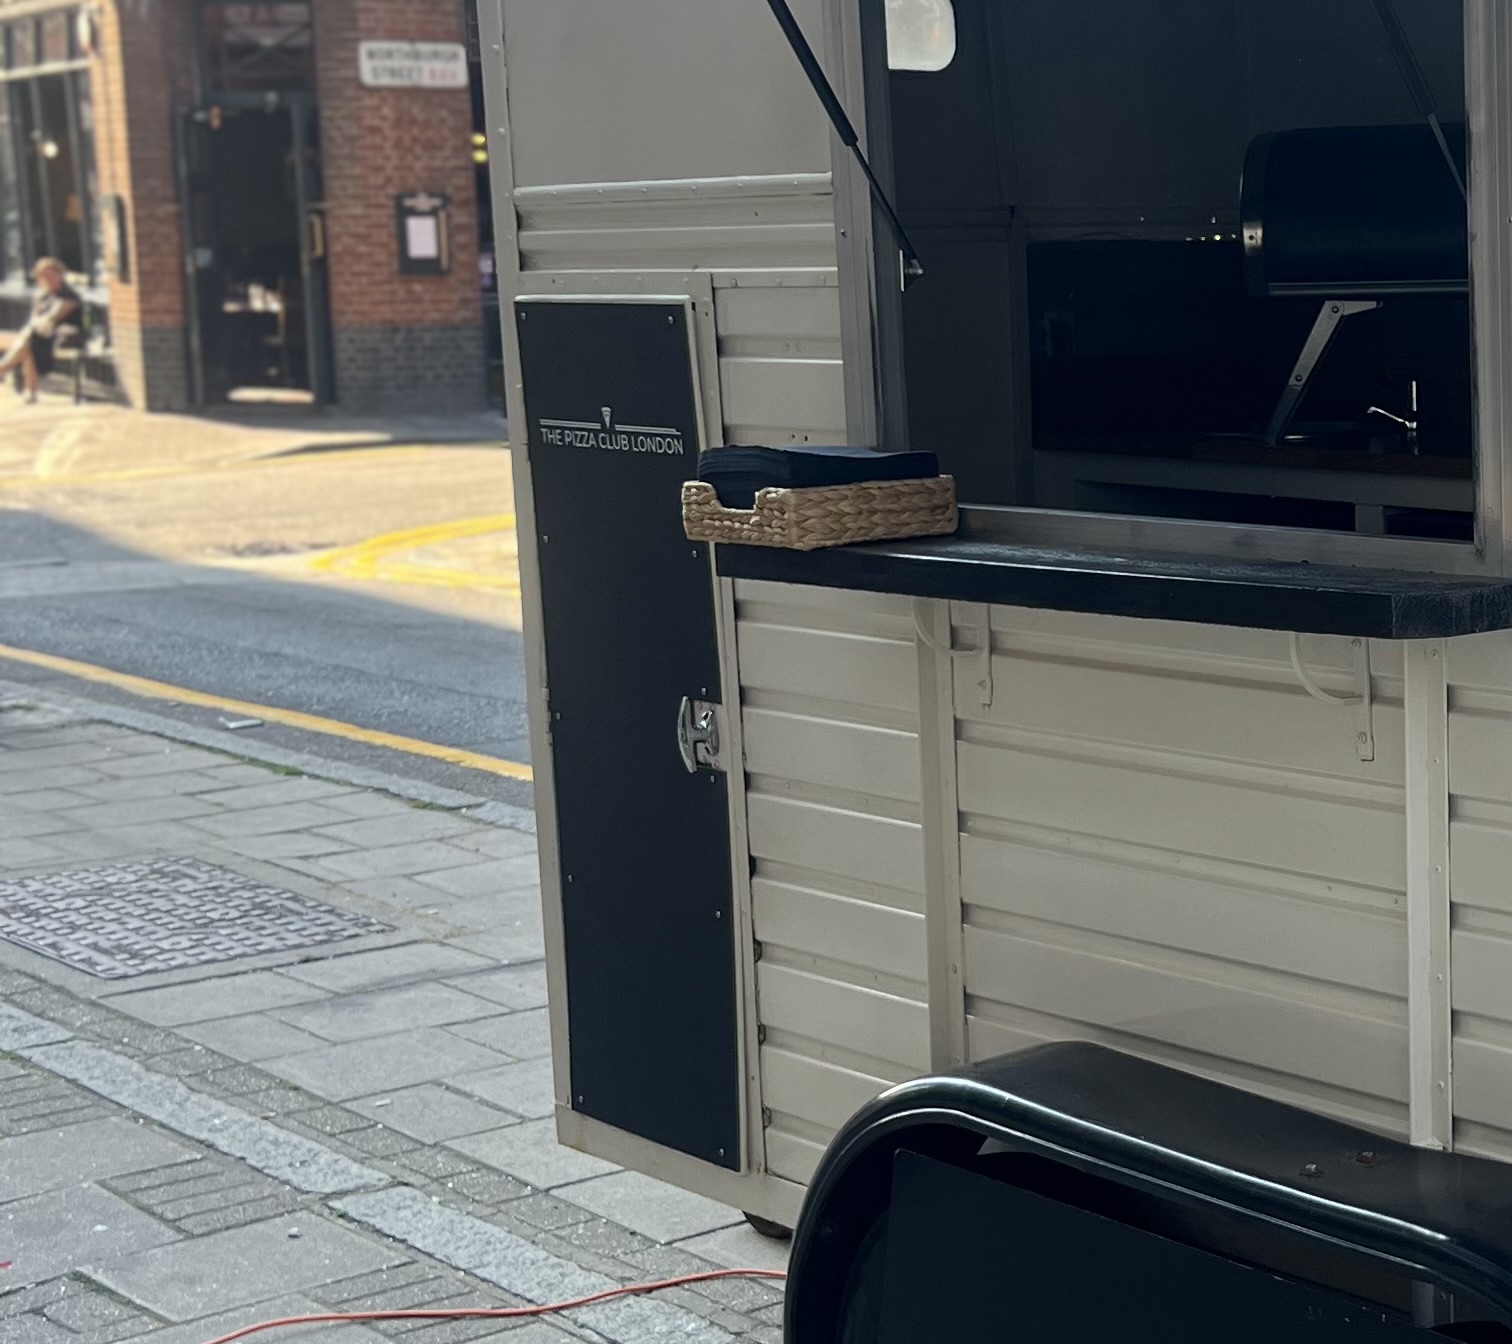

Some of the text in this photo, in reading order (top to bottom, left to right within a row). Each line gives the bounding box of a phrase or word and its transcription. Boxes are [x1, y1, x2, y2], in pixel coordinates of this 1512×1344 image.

[540, 428, 684, 455] THE PIZZA CLUB LONDON
